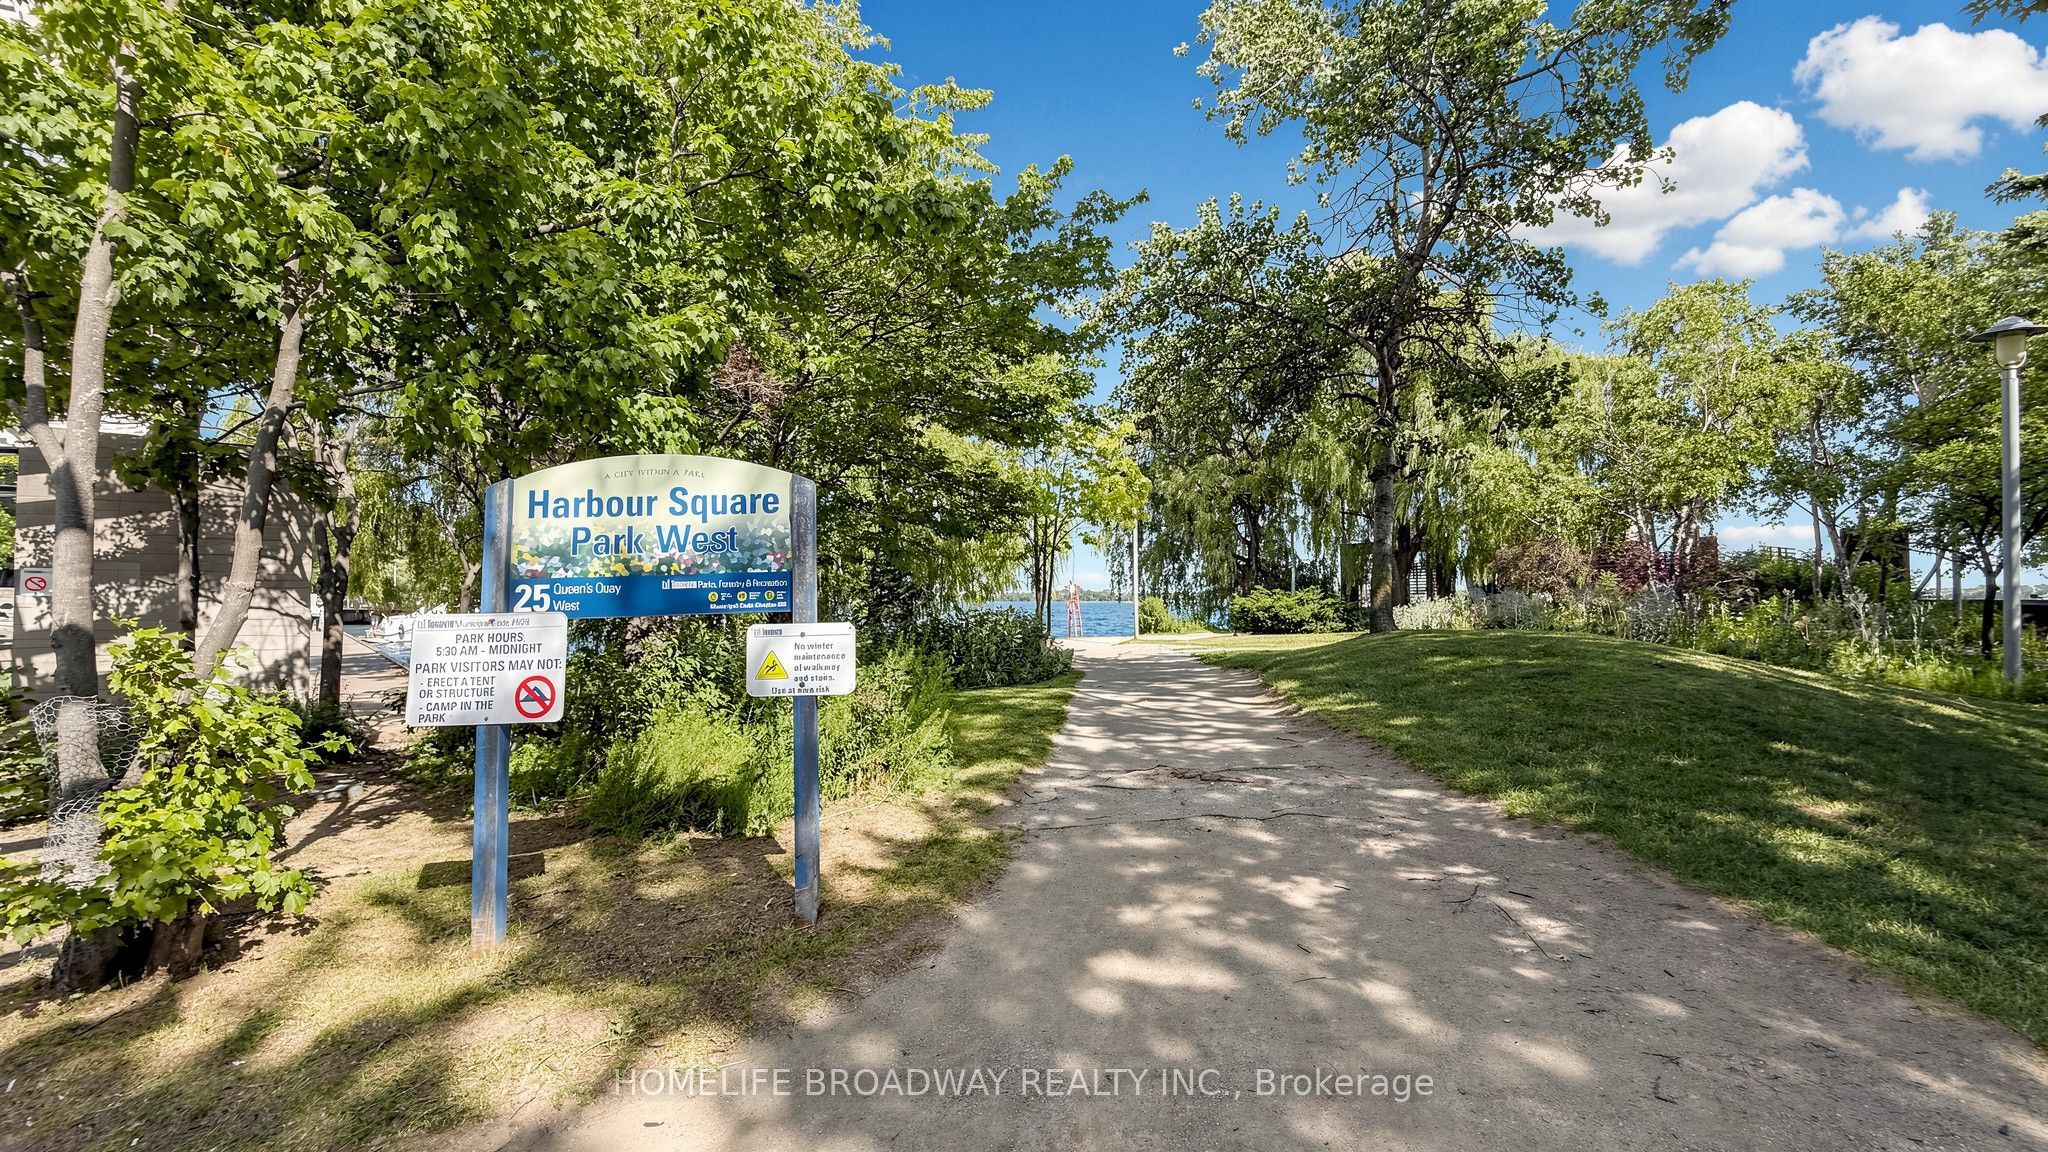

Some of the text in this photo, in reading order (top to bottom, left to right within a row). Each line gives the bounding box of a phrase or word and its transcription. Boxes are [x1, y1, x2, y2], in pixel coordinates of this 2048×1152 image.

[528, 486, 780, 524] Harbour Square
[571, 524, 738, 556] Park West
[553, 582, 621, 595] Queen's Quay
[514, 584, 550, 612] 25
[553, 600, 580, 611] West
[456, 633, 483, 644] PARK
[436, 646, 458, 656] 5:30
[459, 646, 478, 655] AM
[489, 643, 542, 655] MIDNIGHT
[794, 642, 833, 650] No winter
[416, 659, 562, 674] PARK VISITORS MAY NOT:
[427, 677, 461, 687] ERECT
[461, 678, 468, 686] A
[471, 676, 495, 686] TENT
[419, 687, 495, 698] OR STRUCTURE
[426, 702, 457, 711] CAMP
[460, 701, 473, 710] IN
[475, 700, 494, 710] THE
[418, 713, 446, 723] PARK
